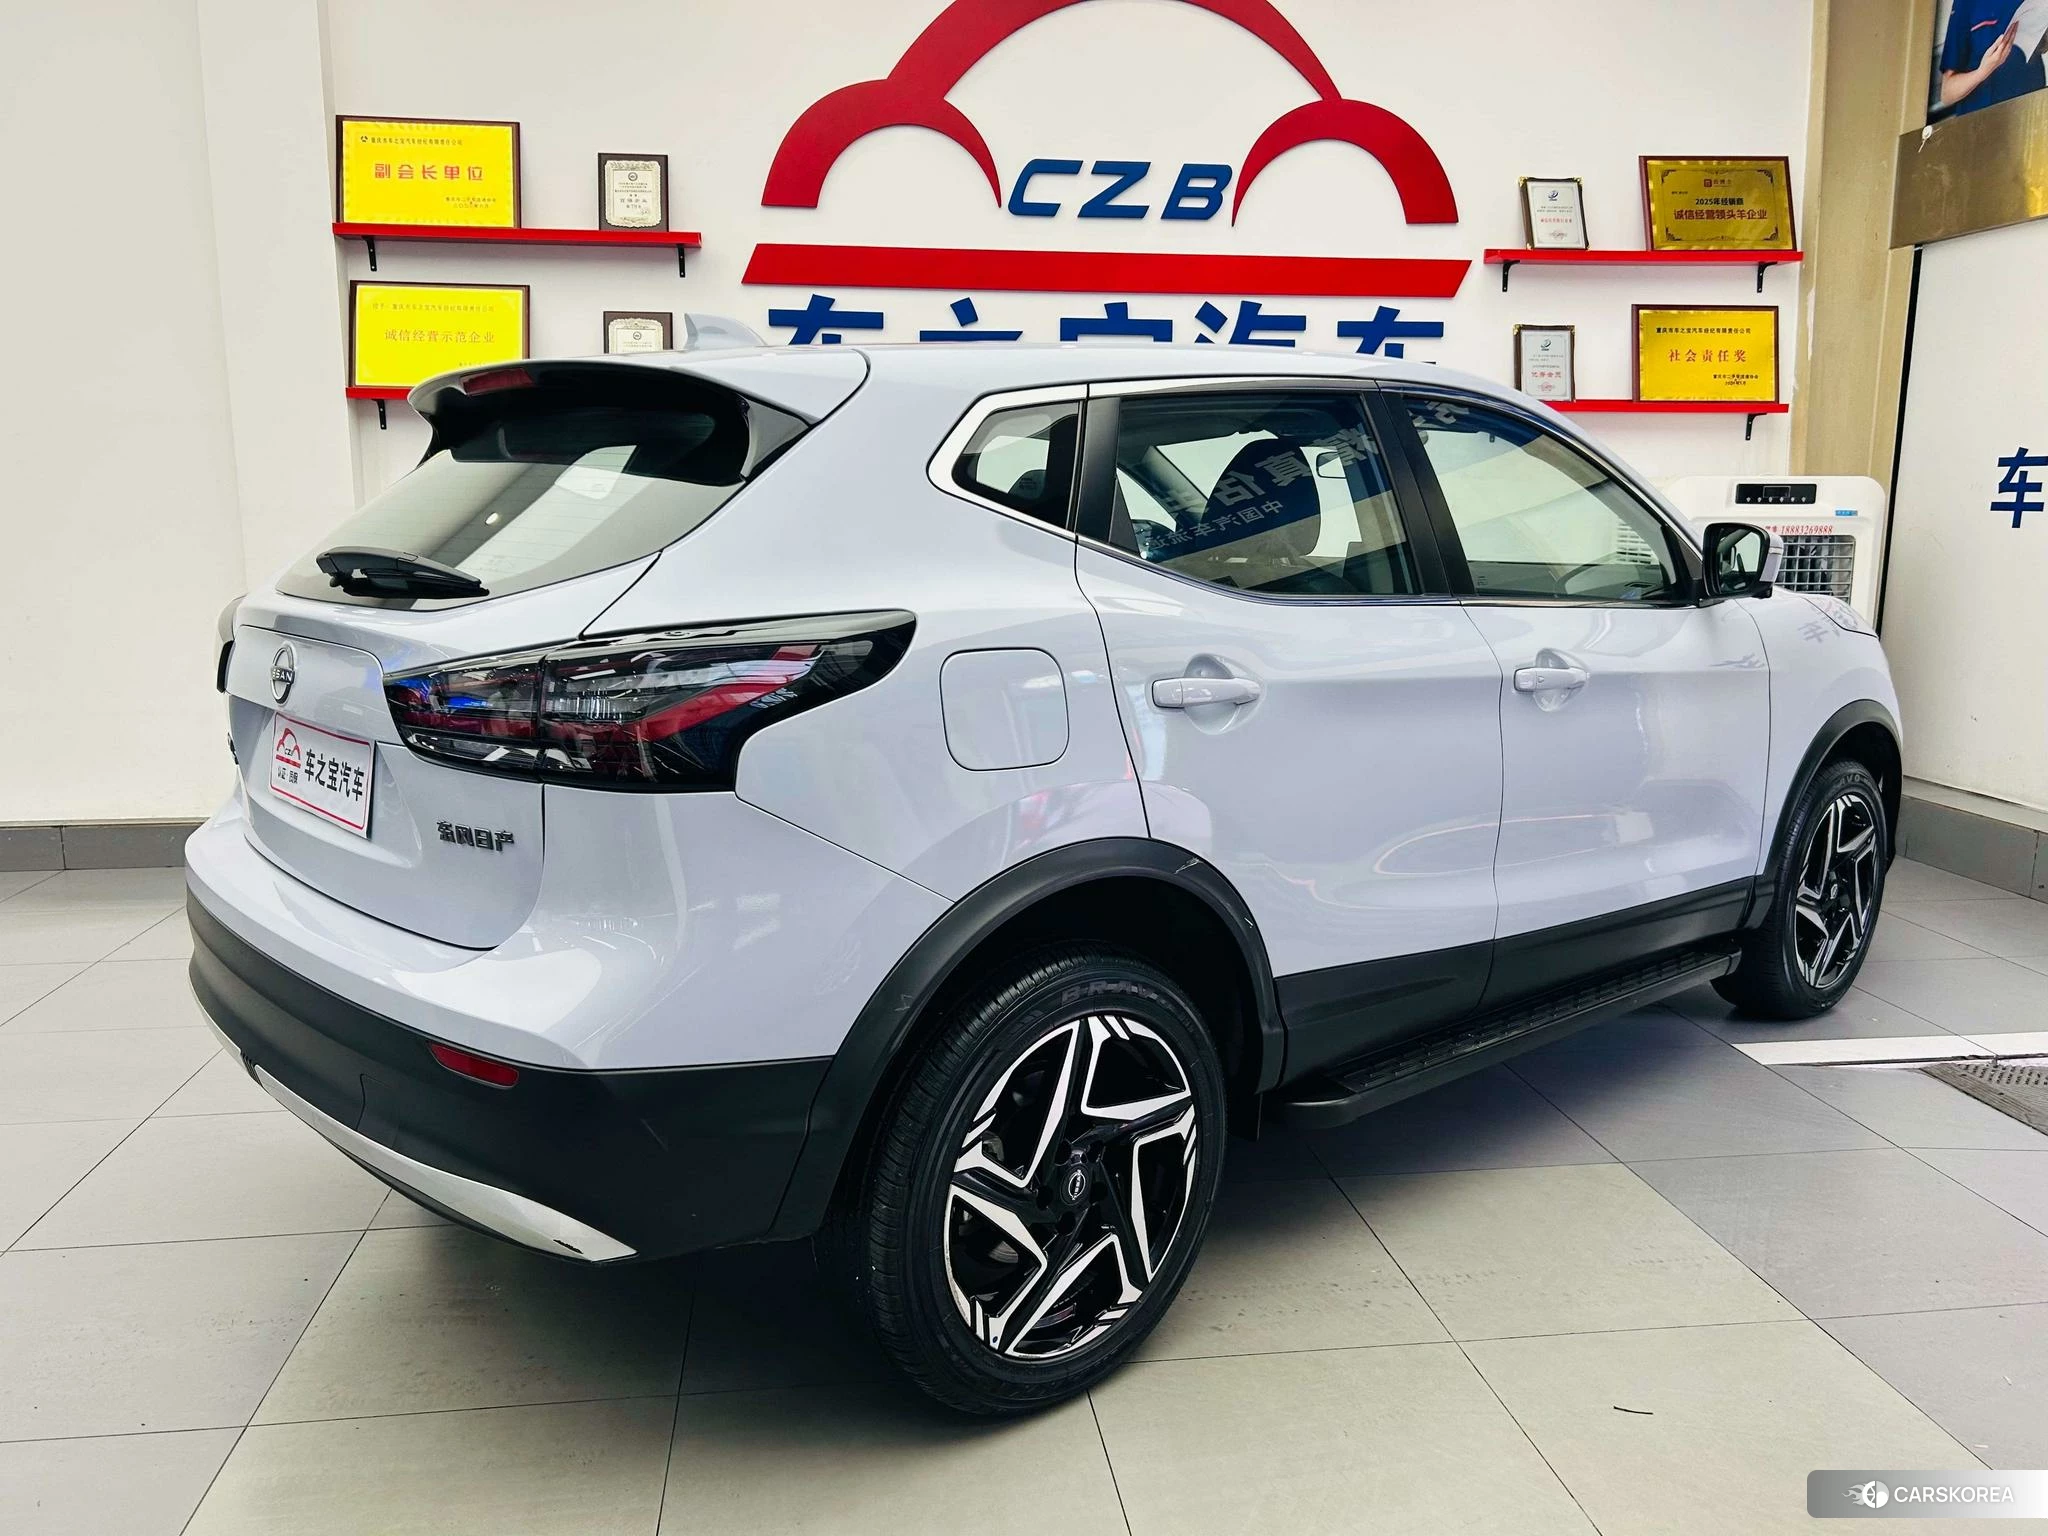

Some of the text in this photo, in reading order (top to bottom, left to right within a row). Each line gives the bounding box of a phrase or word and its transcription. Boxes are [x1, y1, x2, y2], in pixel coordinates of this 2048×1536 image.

[374, 163, 483, 181] 副会长单位
[1008, 158, 1233, 220] CZB
[1673, 209, 1768, 220] 诚信经营领头羊企业
[384, 329, 496, 344] 诚信经营示范企业
[1669, 349, 1747, 362] 社会责任奖
[1990, 447, 2048, 528] 车
[304, 748, 365, 802] 车之宝汽车
[436, 820, 515, 852] 东风日产
